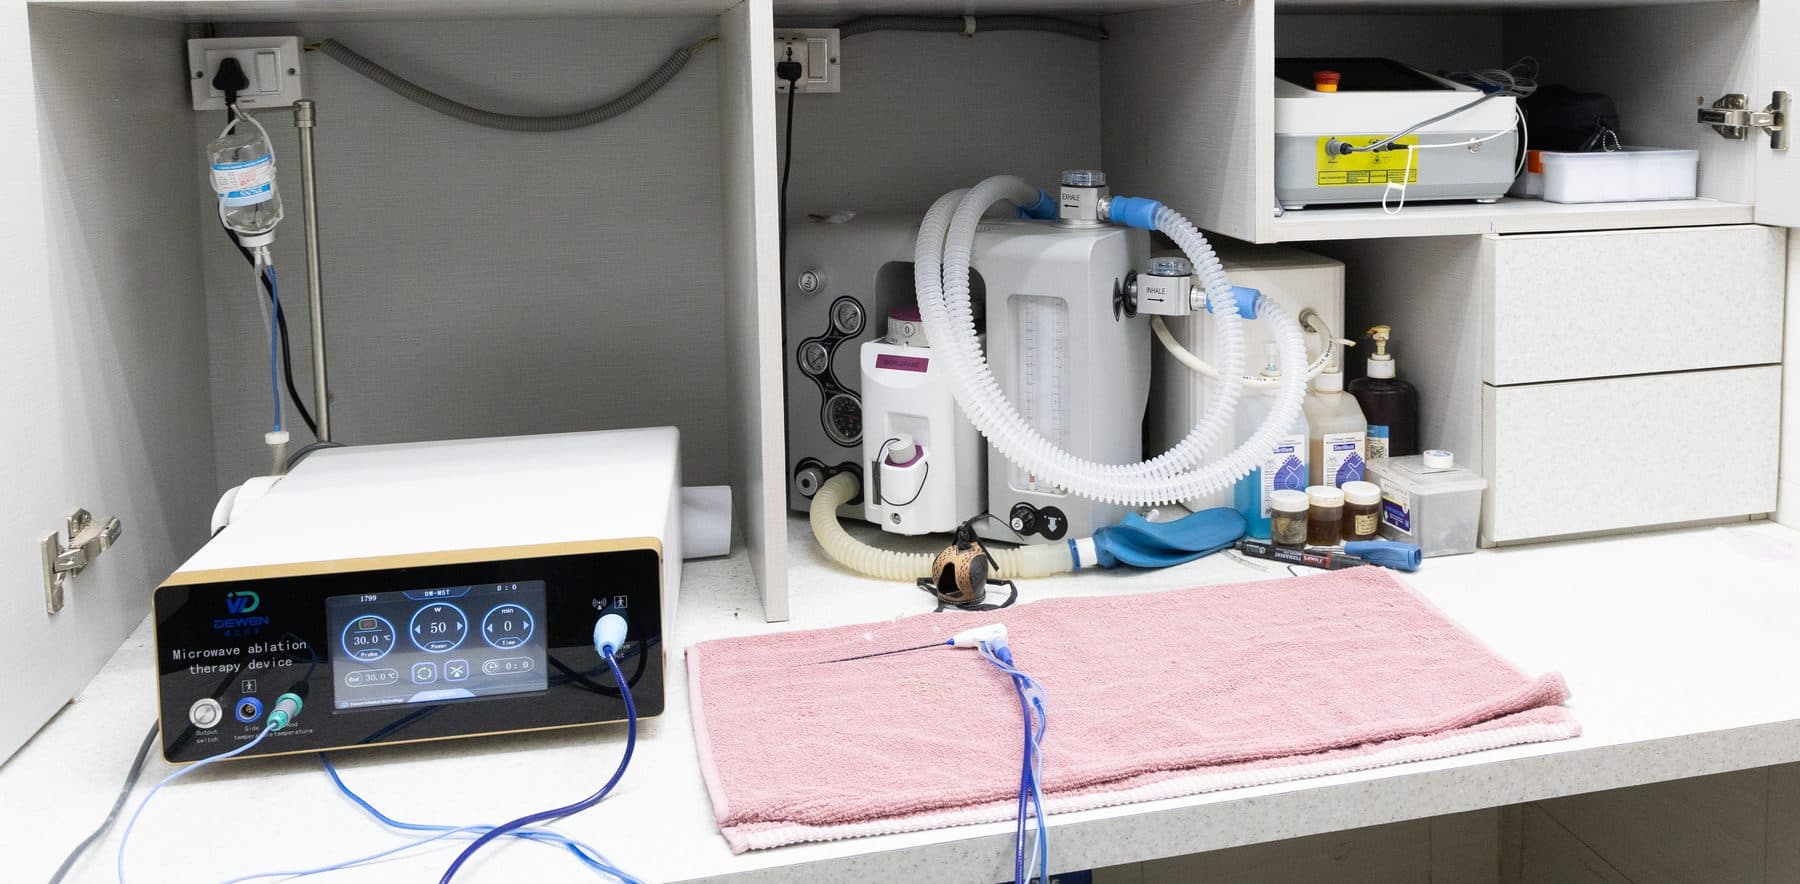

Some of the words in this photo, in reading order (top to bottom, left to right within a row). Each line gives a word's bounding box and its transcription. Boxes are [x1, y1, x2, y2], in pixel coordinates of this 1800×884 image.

[1061, 193, 1080, 201] EXHALE
[1146, 287, 1166, 295] INHALE
[360, 594, 377, 602] 1799
[213, 615, 269, 629] DEWEN
[503, 620, 512, 632] 0
[430, 621, 447, 634] 50
[172, 647, 240, 660] Microwave
[247, 640, 307, 654] ablation
[189, 663, 241, 675] therapy
[248, 657, 293, 670] device
[195, 729, 218, 737] Output
[274, 728, 314, 737] temperature
[196, 736, 219, 744] switch
